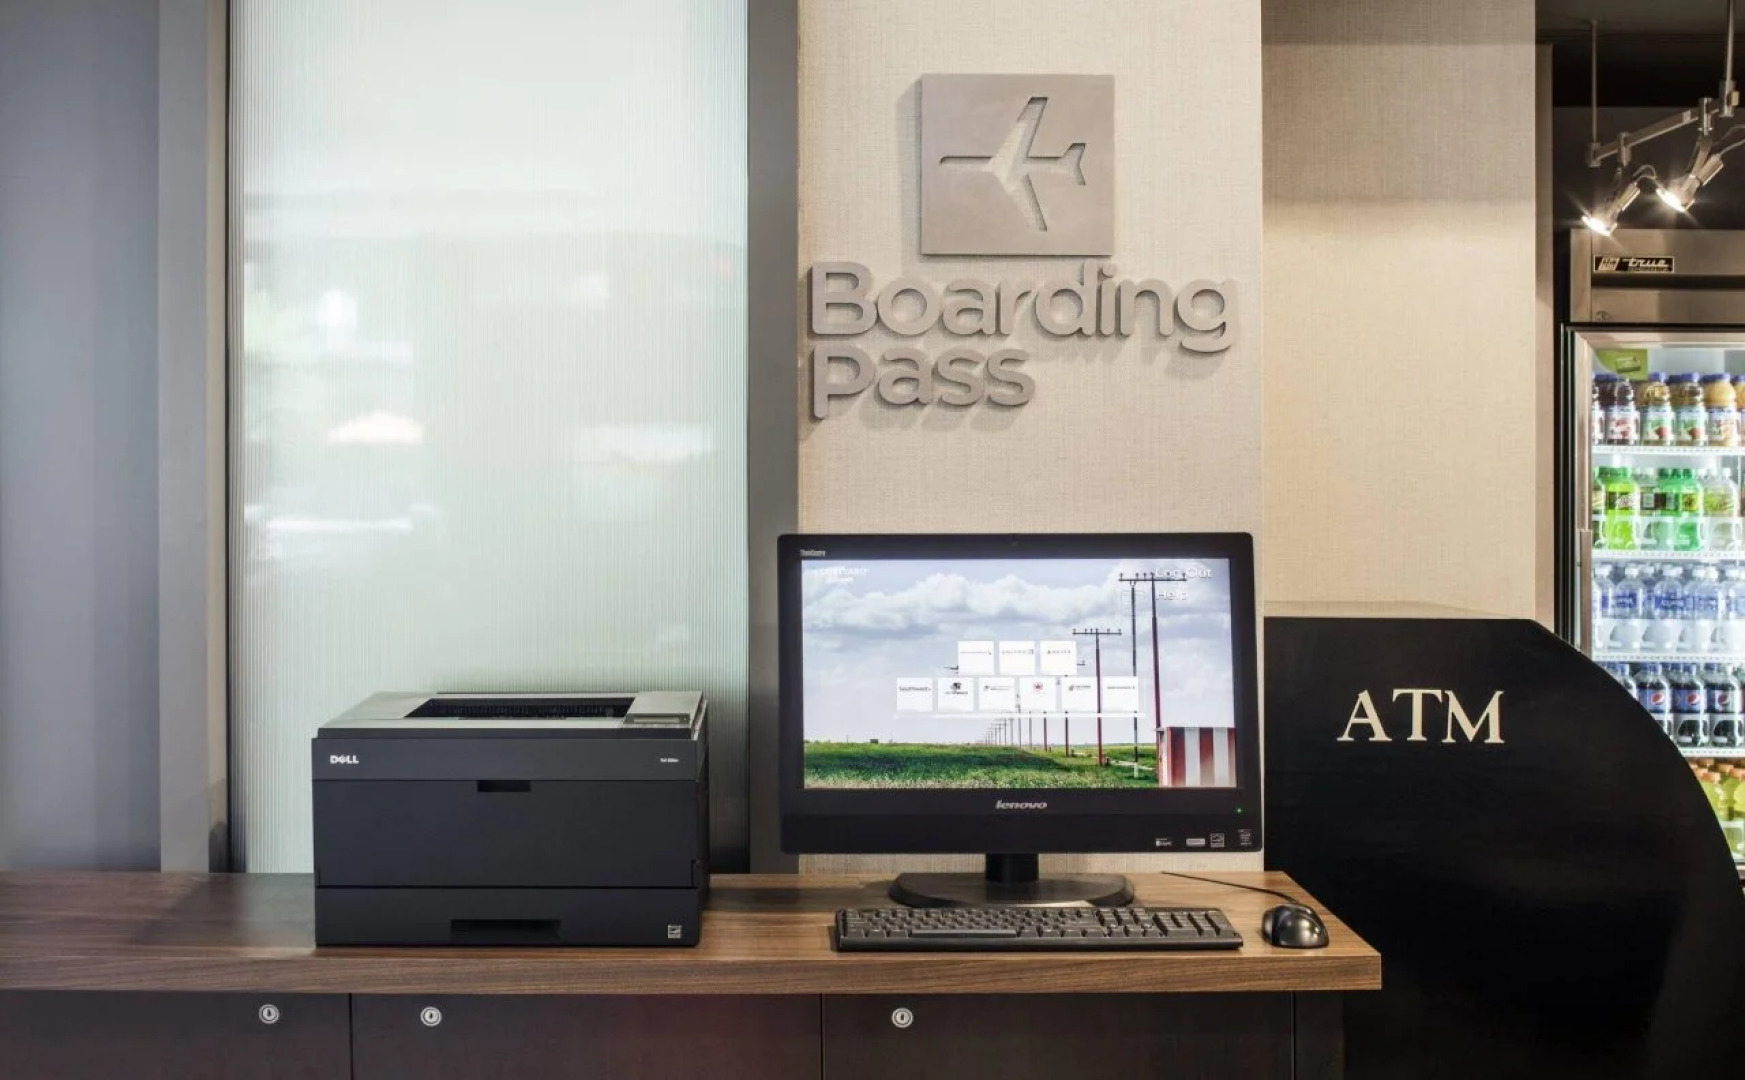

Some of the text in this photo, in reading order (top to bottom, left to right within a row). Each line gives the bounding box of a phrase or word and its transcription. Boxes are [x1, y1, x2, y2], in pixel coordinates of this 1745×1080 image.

[809, 259, 1238, 354] Boarding
[811, 343, 1036, 420] Pass
[1337, 688, 1505, 743] ATM
[330, 754, 360, 764] DELL
[995, 800, 1048, 810] lenovo
